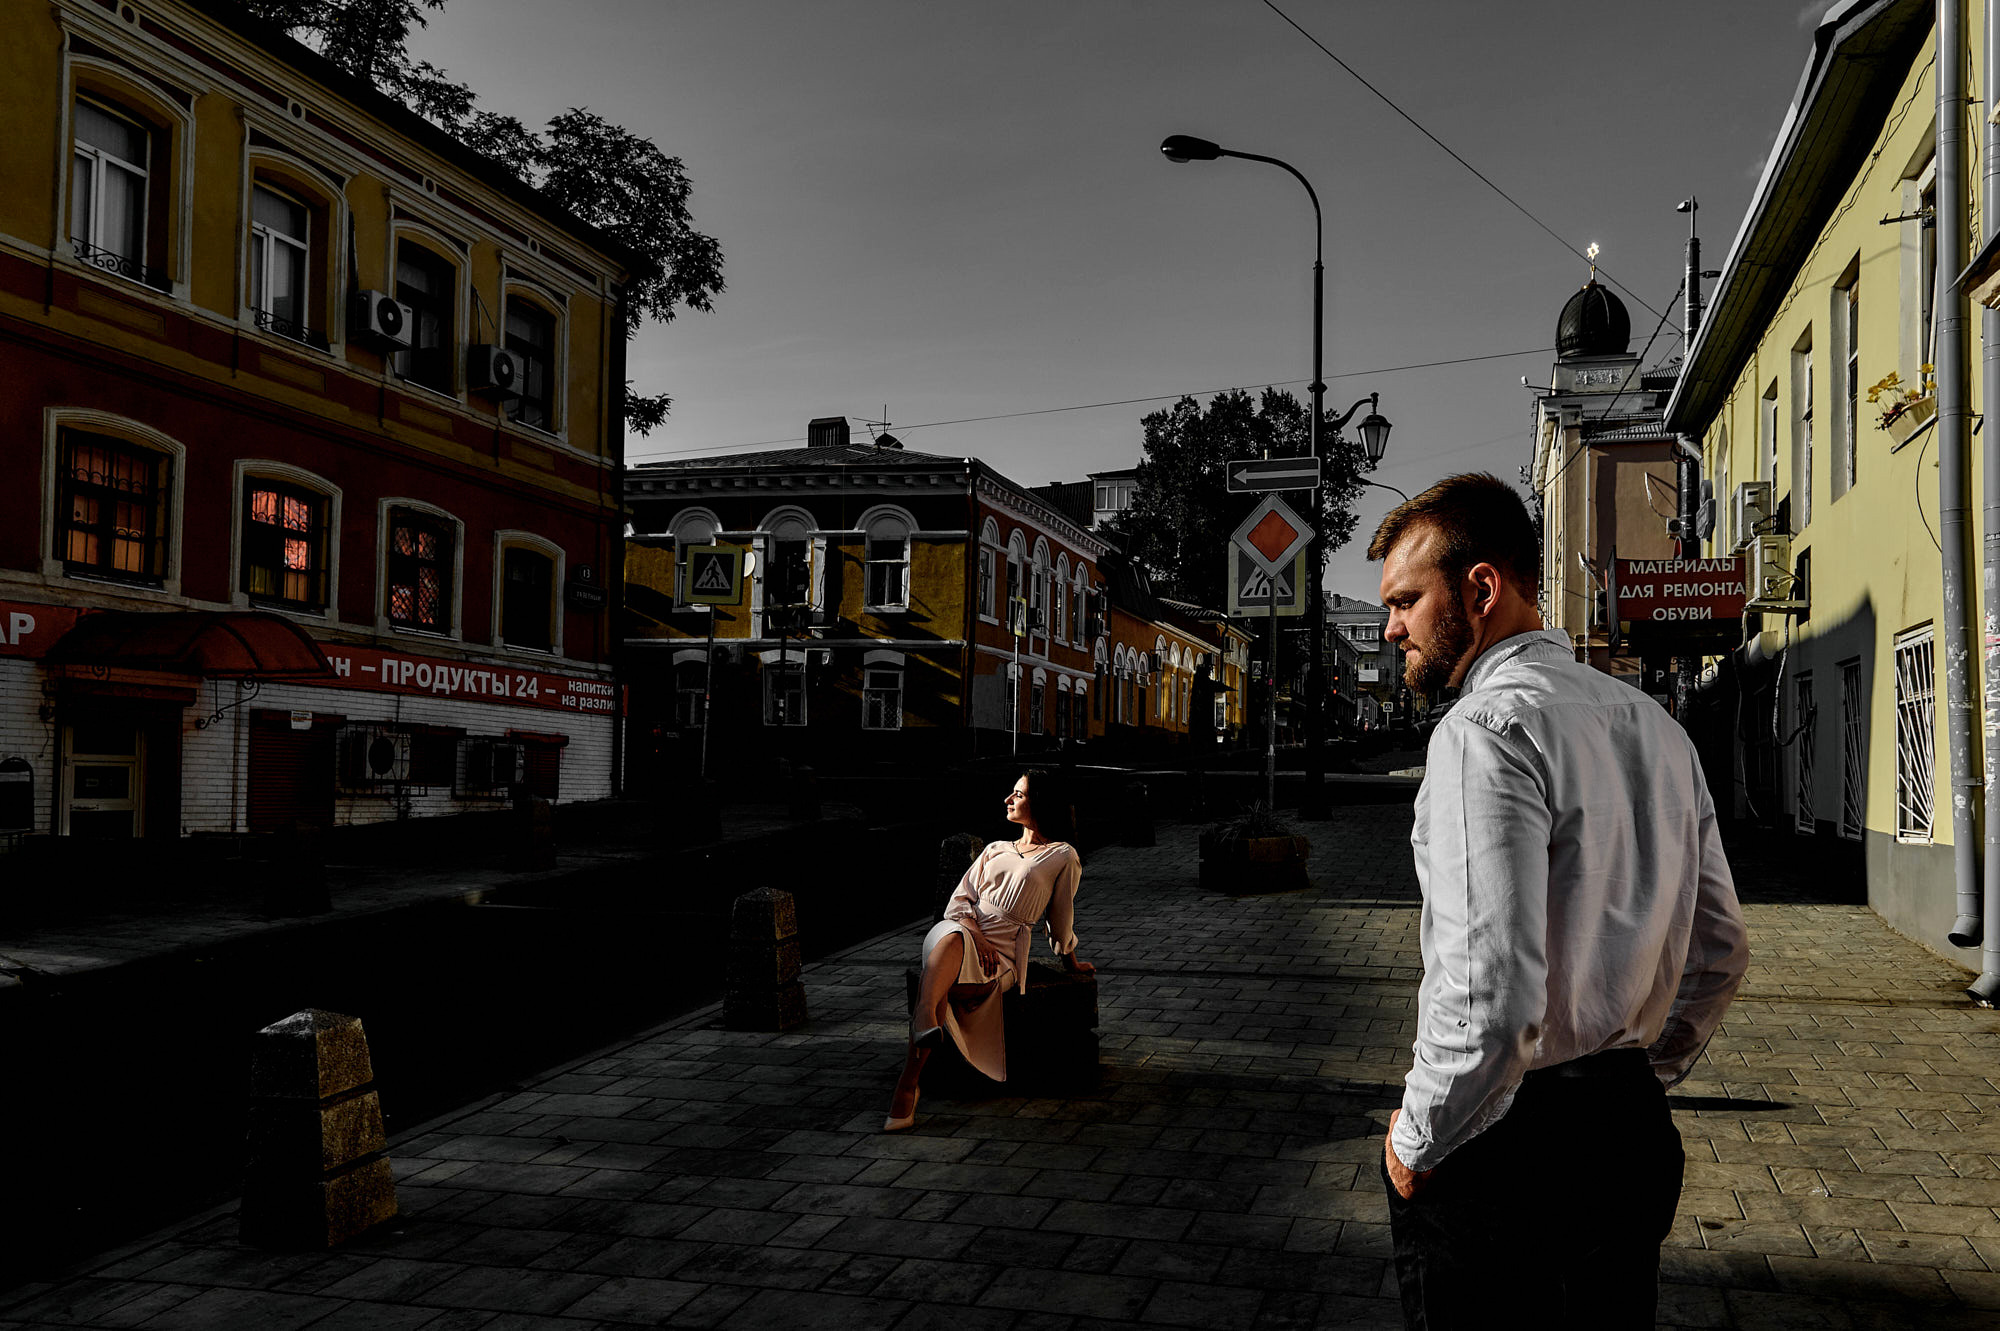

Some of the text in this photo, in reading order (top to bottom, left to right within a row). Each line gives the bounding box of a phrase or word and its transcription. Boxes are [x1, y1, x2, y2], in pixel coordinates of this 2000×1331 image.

[1629, 558, 1736, 574] МАТЕРИАЛЫ
[1619, 582, 1746, 599] ДЛЯ РЕМОНТА
[1652, 607, 1712, 621] ОБУВИ
[381, 658, 510, 696] ПРОДУКТЫ
[515, 675, 539, 699] 24
[568, 680, 614, 696] напитки
[561, 694, 576, 707] на
